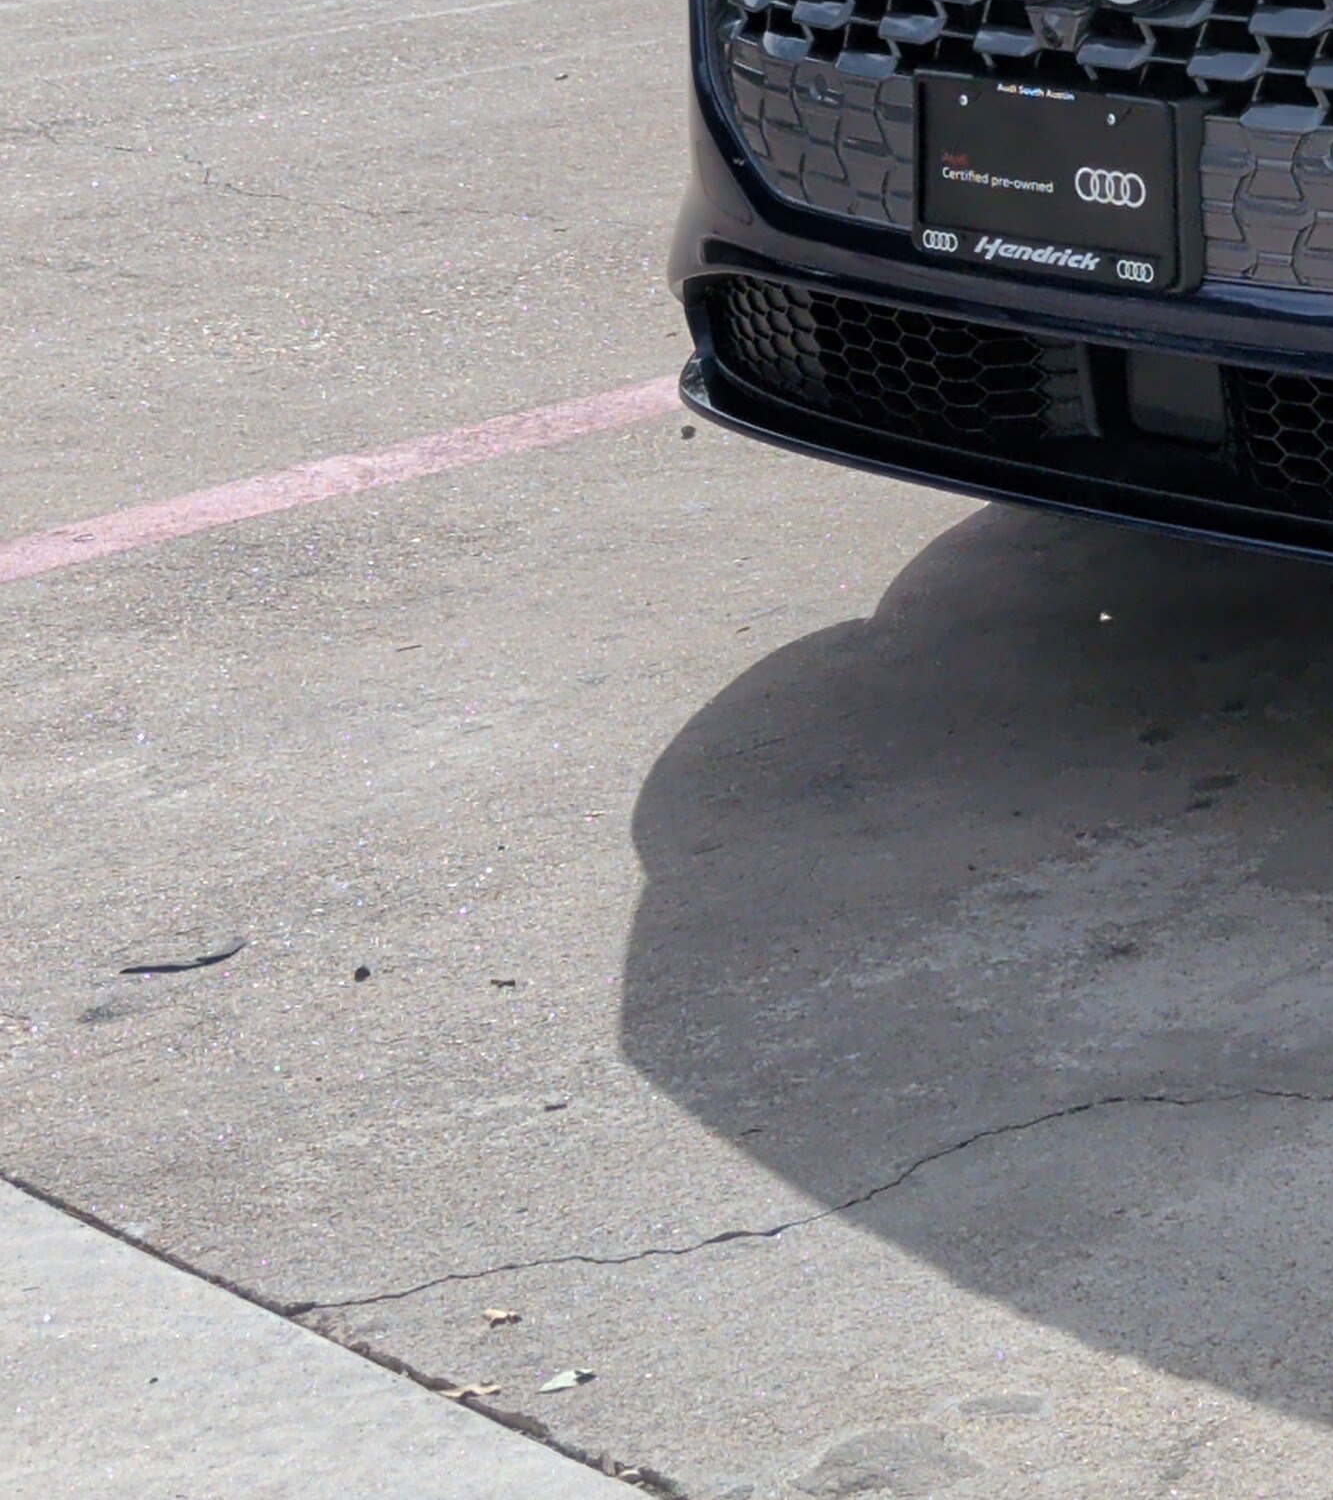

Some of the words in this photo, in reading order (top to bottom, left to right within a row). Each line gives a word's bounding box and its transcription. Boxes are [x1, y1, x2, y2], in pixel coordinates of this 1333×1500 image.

[996, 83, 1017, 94] Audi
[1018, 85, 1044, 98] South
[1046, 89, 1076, 101] Austin
[942, 166, 989, 184] Certified
[991, 176, 1054, 194] pre-owned
[974, 235, 1101, 271] Hendrick
